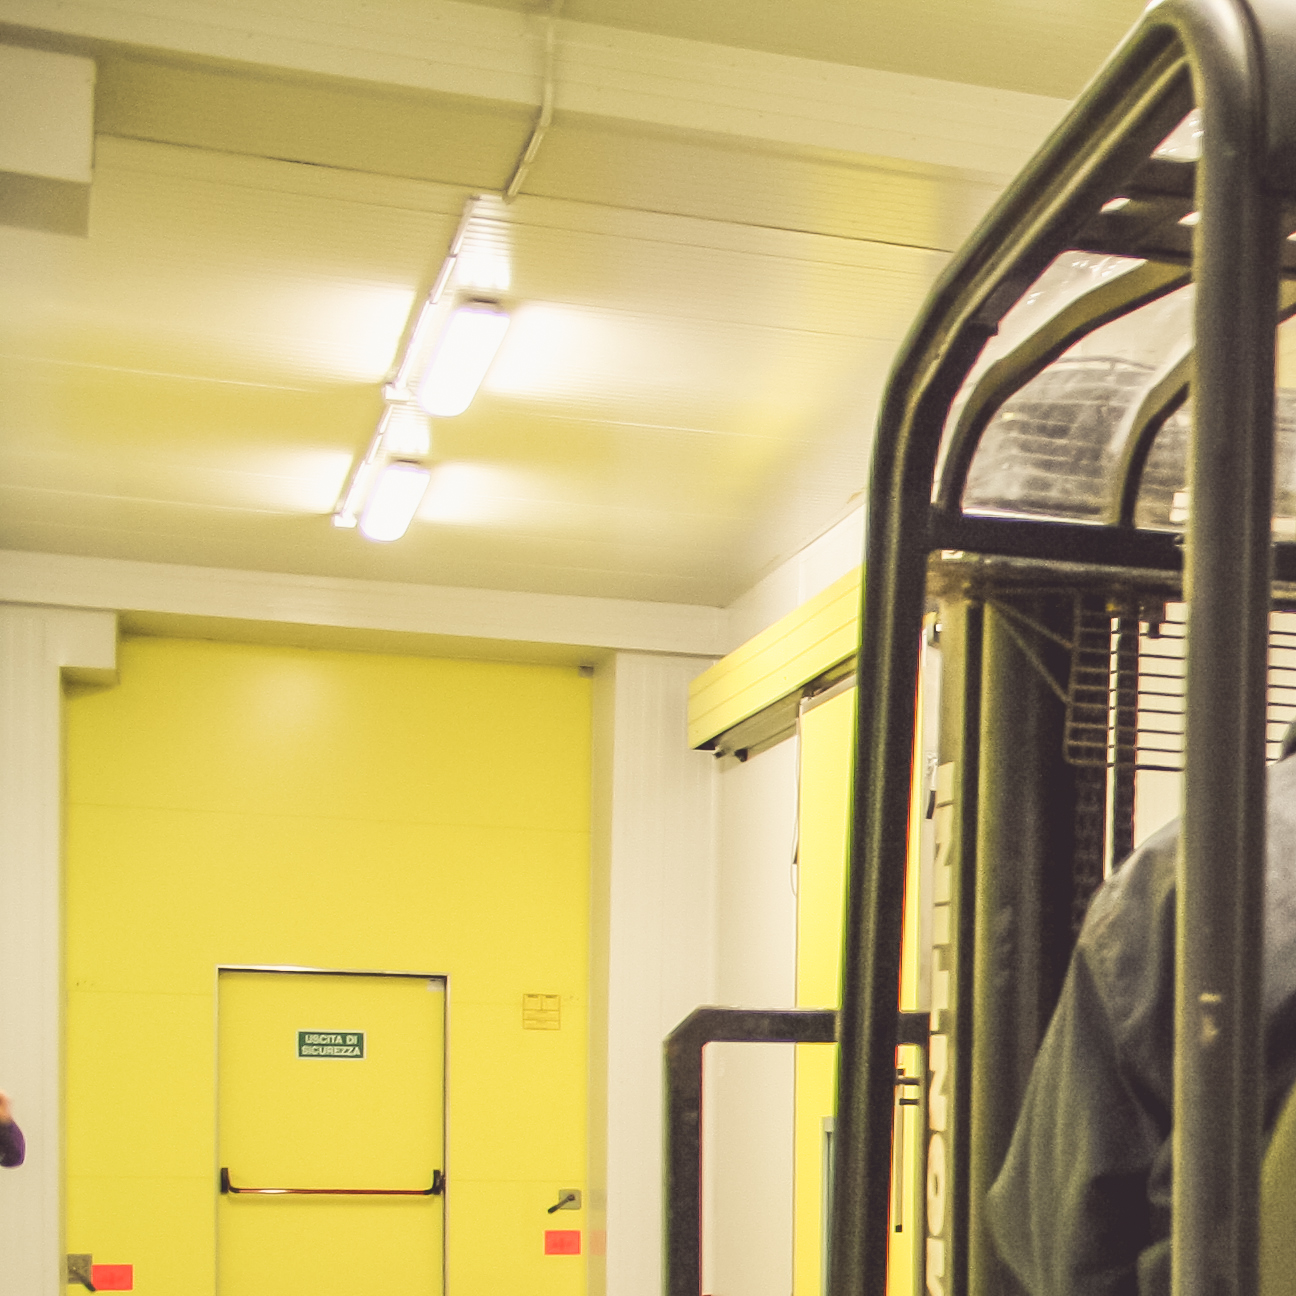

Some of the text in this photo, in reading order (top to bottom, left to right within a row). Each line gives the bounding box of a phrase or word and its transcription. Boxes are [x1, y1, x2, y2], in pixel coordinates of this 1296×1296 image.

[304, 1034, 358, 1045] USCITA DI
[301, 1045, 361, 1056] SICUREZZA
